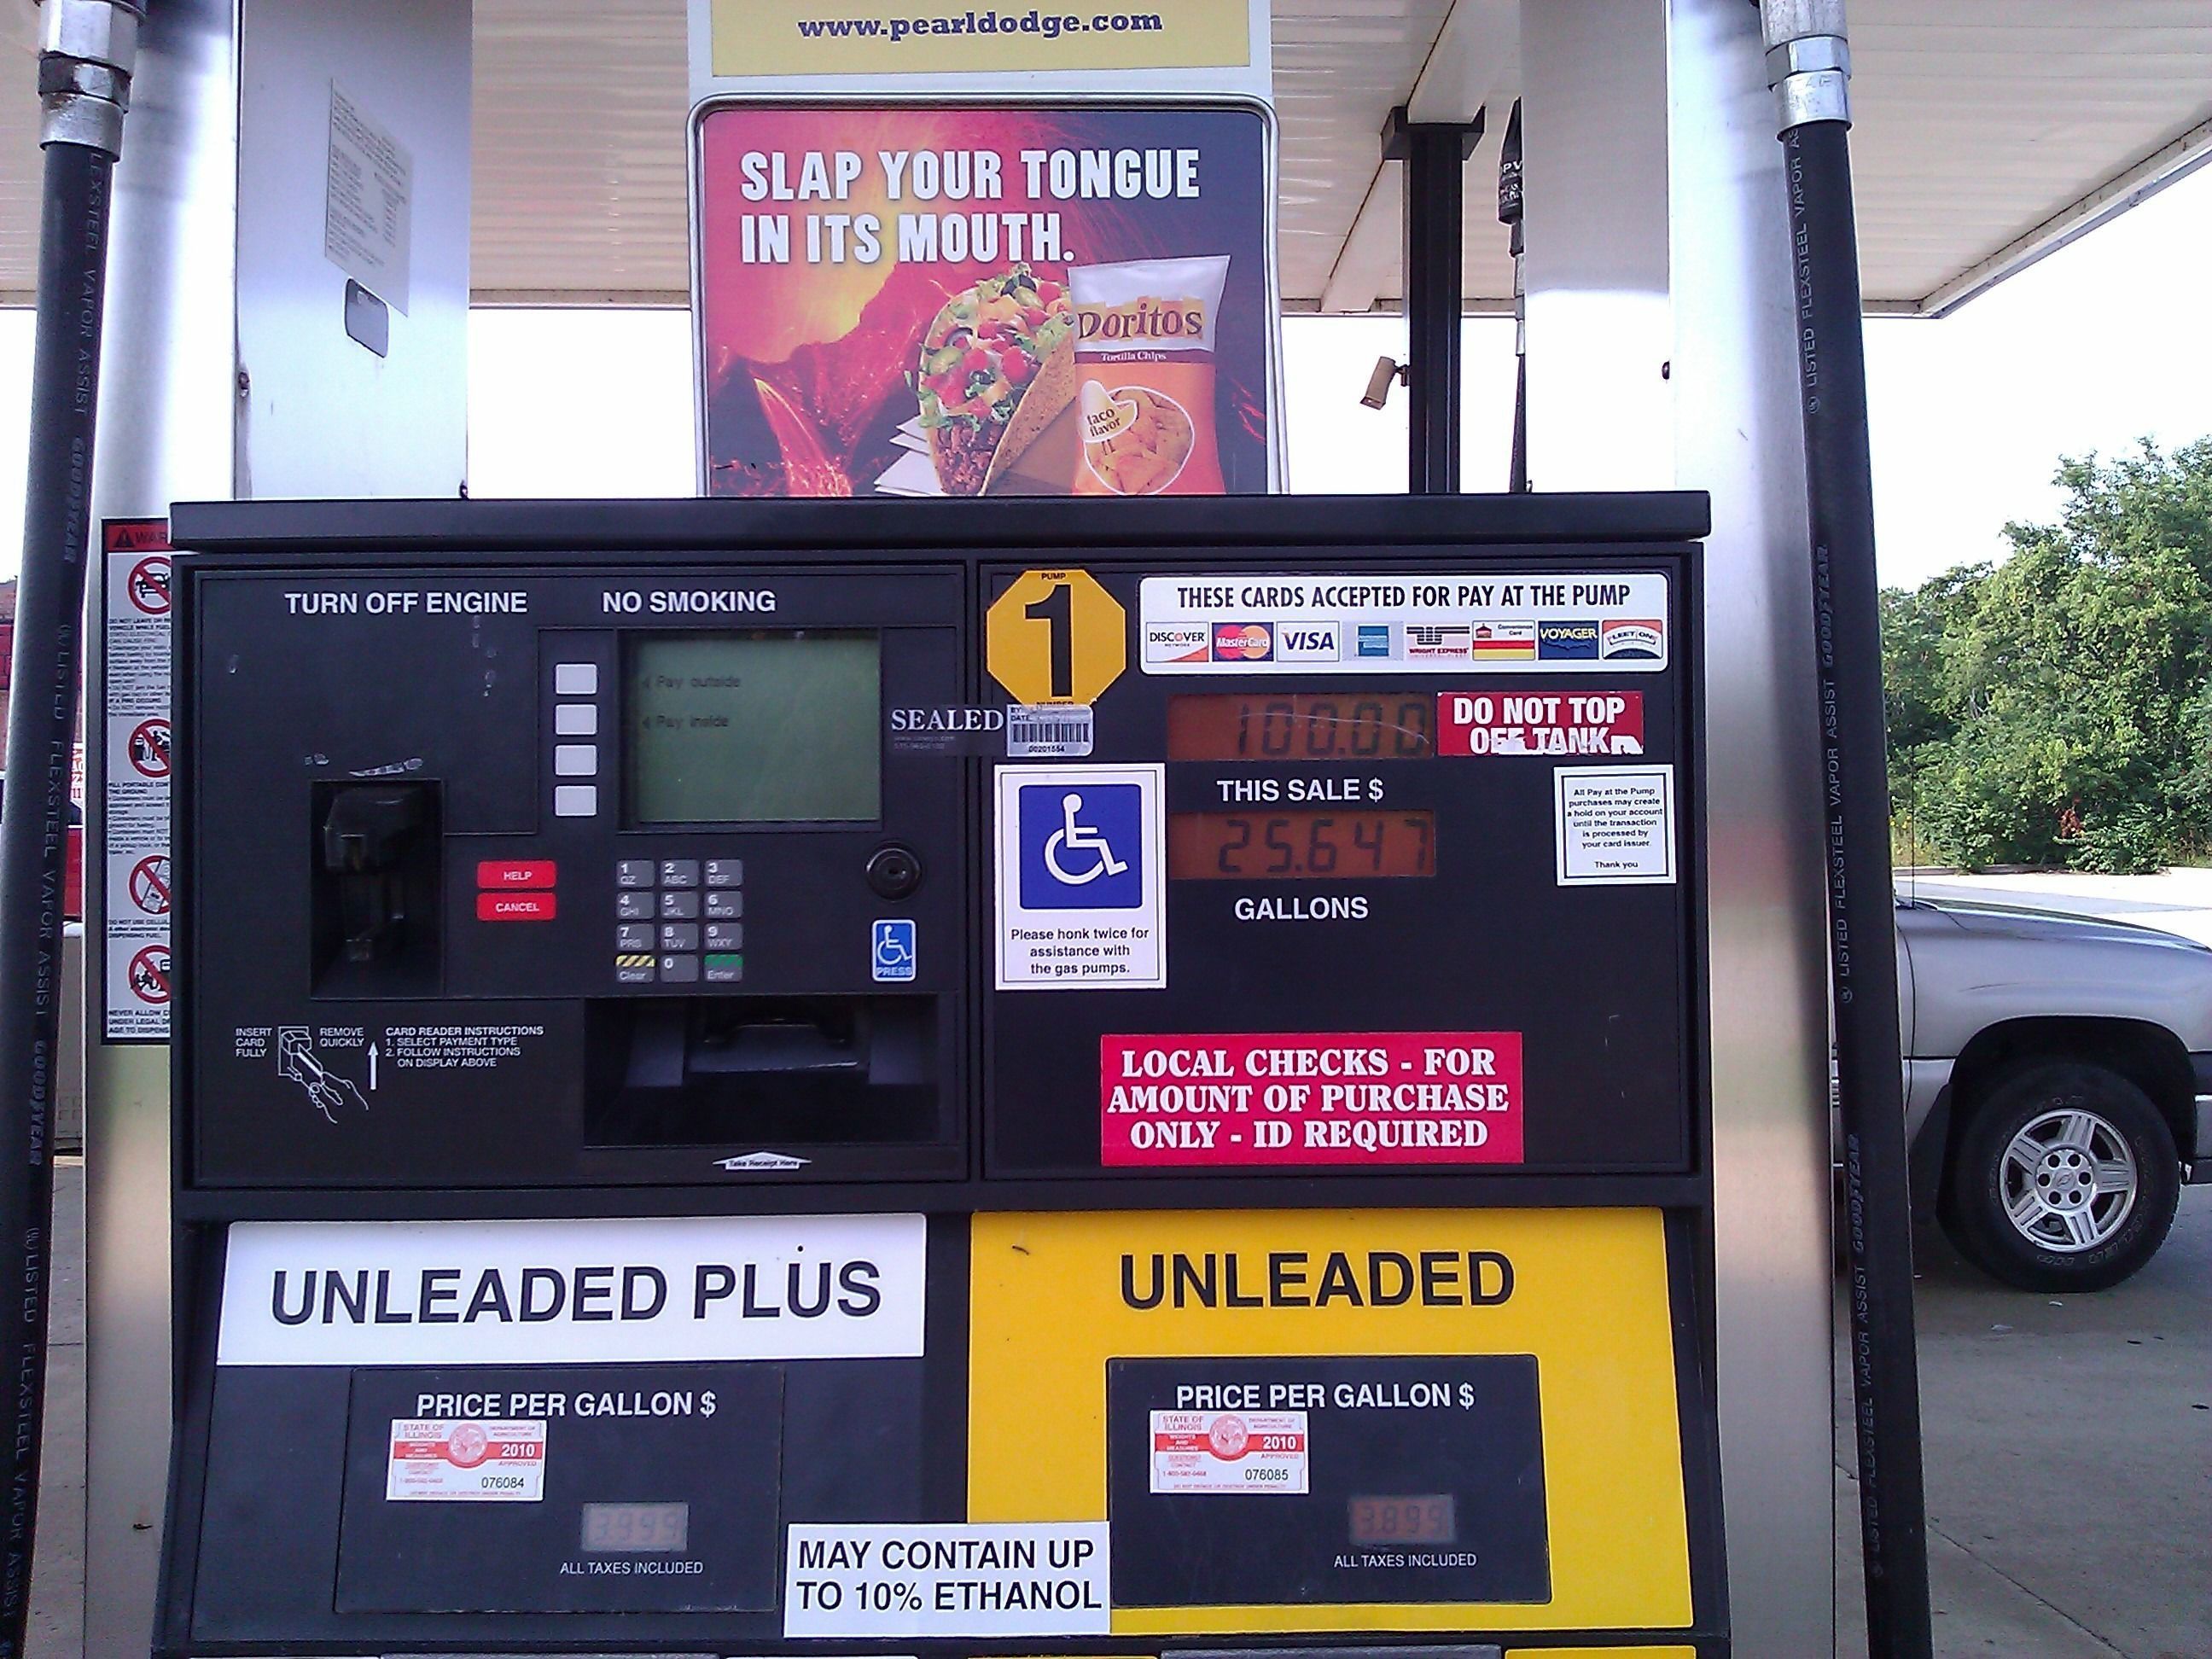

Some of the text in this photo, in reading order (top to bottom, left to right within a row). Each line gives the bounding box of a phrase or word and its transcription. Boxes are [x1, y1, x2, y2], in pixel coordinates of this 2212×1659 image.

[799, 11, 1162, 41] www.pearldodge.com
[741, 148, 1201, 201] SLAP YOUR TONGUE
[1792, 157, 1806, 218] VAPOR
[741, 212, 1075, 263] IN ITS MOUTH.
[1796, 224, 1813, 319] FLEXSTEEL
[1078, 302, 1202, 339] Doritos
[1101, 351, 1167, 362] Tortilla Chips
[1803, 329, 1818, 387] LISTED
[1086, 408, 1115, 425] taco
[1089, 417, 1121, 437] flavor
[1041, 573, 1067, 581] PUMP
[284, 591, 527, 614] TURN OFF ENGINE
[602, 591, 777, 613] NO SMOKING
[1178, 585, 1631, 608] THESE CARDS ACCEPTED FOR PAY AT THE PUMP
[1150, 632, 1205, 643] DISCOVER
[1540, 627, 1598, 640] VOYAGER
[1025, 584, 1073, 697] 1
[1216, 637, 1270, 648] MasterCard
[1283, 632, 1334, 650] VISA
[1453, 696, 1625, 725] DO NOT TOP
[656, 715, 683, 731] Pay
[891, 709, 1004, 731] SEALED
[1533, 727, 1610, 754] TANK
[1218, 777, 1384, 802] THIS SALE $
[1587, 789, 1602, 797] Pay
[1631, 788, 1655, 796] Pump
[1569, 800, 1612, 808] purchases
[1823, 678, 1850, 976] LISTED FLEXSTEEL VAPOR ASSIST
[1592, 829, 1649, 839] processed by
[1582, 841, 1600, 849] your
[504, 871, 533, 881] HELP
[665, 895, 674, 905] 5
[708, 894, 718, 905] 6
[495, 902, 539, 912] CANCEL
[1235, 897, 1369, 920] GALLONS
[620, 927, 629, 937] 7
[665, 927, 674, 937] 8
[708, 927, 718, 937] 9
[1011, 927, 1149, 940] Please honk twice for
[1030, 944, 1130, 957] assistance with
[665, 958, 673, 969] 0
[1031, 963, 1130, 976] the gas pumps.
[707, 970, 734, 981] Enter
[876, 967, 912, 976] PRESS
[236, 1028, 272, 1037] INSERT
[320, 1027, 364, 1036] REMOVE
[386, 1026, 544, 1036] CARD READER INSTRUCTIONS
[236, 1038, 265, 1047] CARD
[320, 1038, 364, 1048] QUICKLY
[396, 1037, 518, 1047] SELECT PAYMENT TYPE
[236, 1048, 267, 1057] FULLY
[397, 1047, 521, 1057] FOLLOW INSTRUCTIONS
[397, 1057, 497, 1067] ON DISPLAY ABOVE
[1121, 1049, 1496, 1077] LOCAL CHECKS FOR
[1107, 1084, 1510, 1113] AMOUNT OF PURCHASE
[1131, 1120, 1487, 1152] ONLY ID REQUIRED
[1121, 1251, 1516, 1309] UNLEADED
[271, 1260, 883, 1325] UNLEADED PLUS
[1176, 1382, 1475, 1410] PRICE PER GALLON $
[416, 1391, 717, 1417] PRICE PER GALLON $
[1263, 1436, 1296, 1449] 2010
[501, 1444, 535, 1457] 2010
[1245, 1469, 1289, 1480] 076085
[481, 1477, 524, 1488] 076084
[798, 1539, 1094, 1569] MAY CONTAIN UP
[1334, 1554, 1477, 1568] ALL TAXES INCLUDED
[560, 1562, 704, 1575] ALL TAXES INCLUDED
[796, 1580, 1103, 1611] TO 10% ETHANOL
